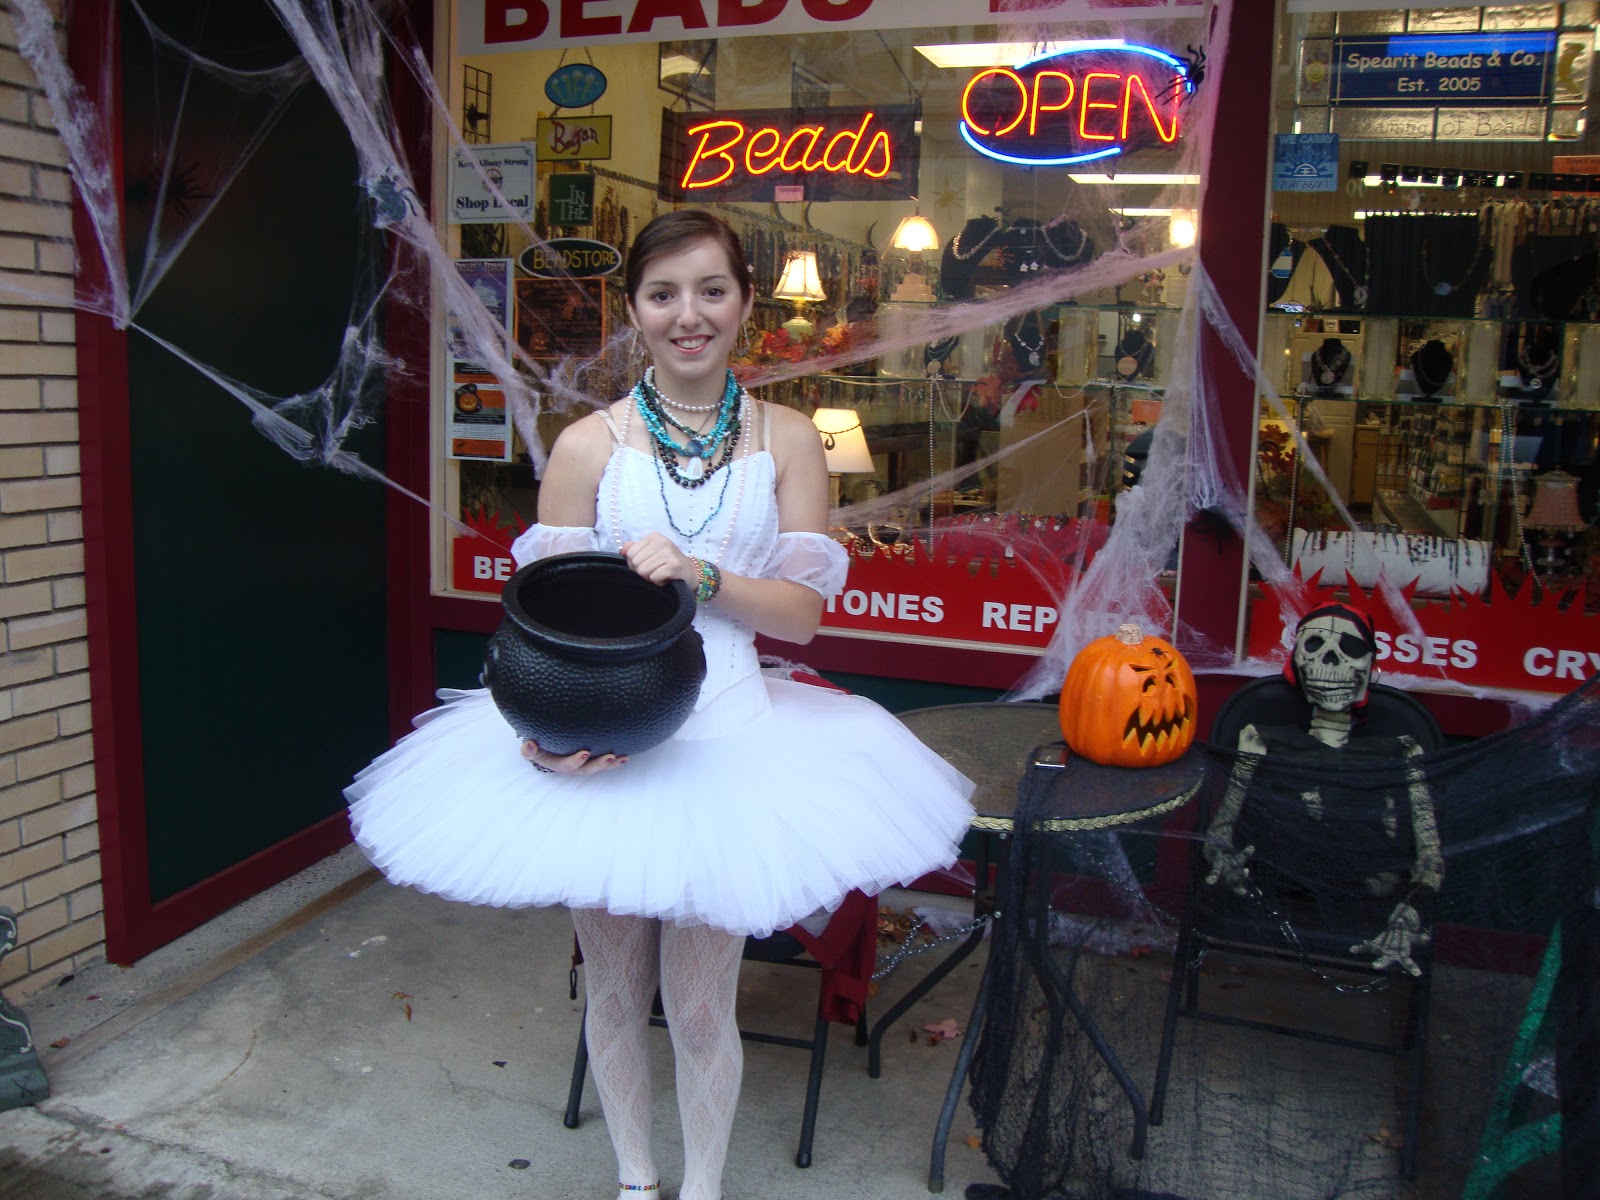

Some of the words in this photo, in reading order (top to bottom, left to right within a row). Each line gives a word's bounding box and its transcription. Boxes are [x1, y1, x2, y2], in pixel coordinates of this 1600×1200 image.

[484, 0, 874, 44] BEA
[1346, 52, 1418, 73] Spearit
[1424, 51, 1482, 68] Beads
[1486, 49, 1501, 63] &
[1510, 49, 1542, 66] Co.
[1397, 77, 1430, 92] Est.
[1438, 77, 1481, 91] 2005
[961, 67, 1181, 143] OPEN
[1474, 109, 1539, 137] Beads
[681, 112, 892, 190] Beads
[504, 158, 528, 166] Strong
[456, 196, 489, 211] Shop
[493, 195, 529, 208] Lcal
[569, 184, 586, 205] IN
[555, 199, 589, 220] THE
[533, 249, 617, 269] BEADSTORE
